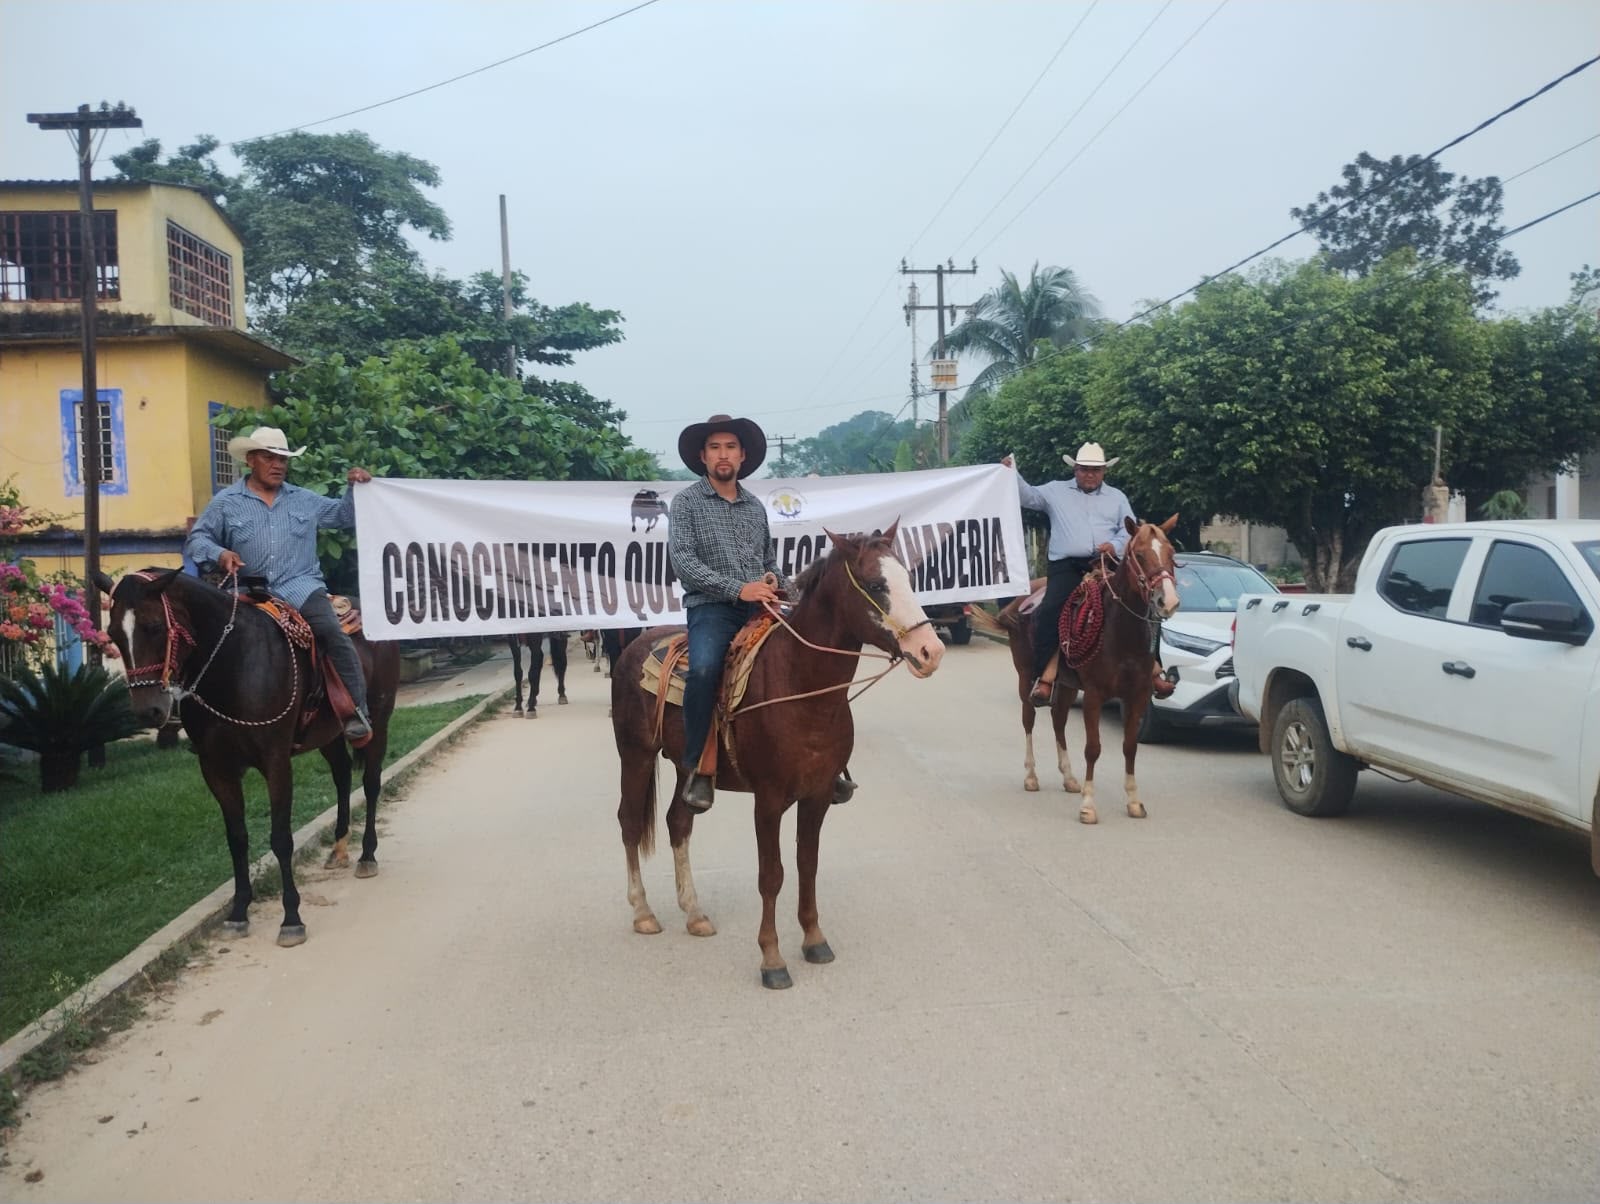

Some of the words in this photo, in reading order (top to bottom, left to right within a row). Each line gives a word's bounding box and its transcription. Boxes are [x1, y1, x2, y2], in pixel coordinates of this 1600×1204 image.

[382, 541, 619, 625] CONOCIMIENTO
[624, 541, 682, 621] QUE
[872, 517, 1010, 594] NADERIA
